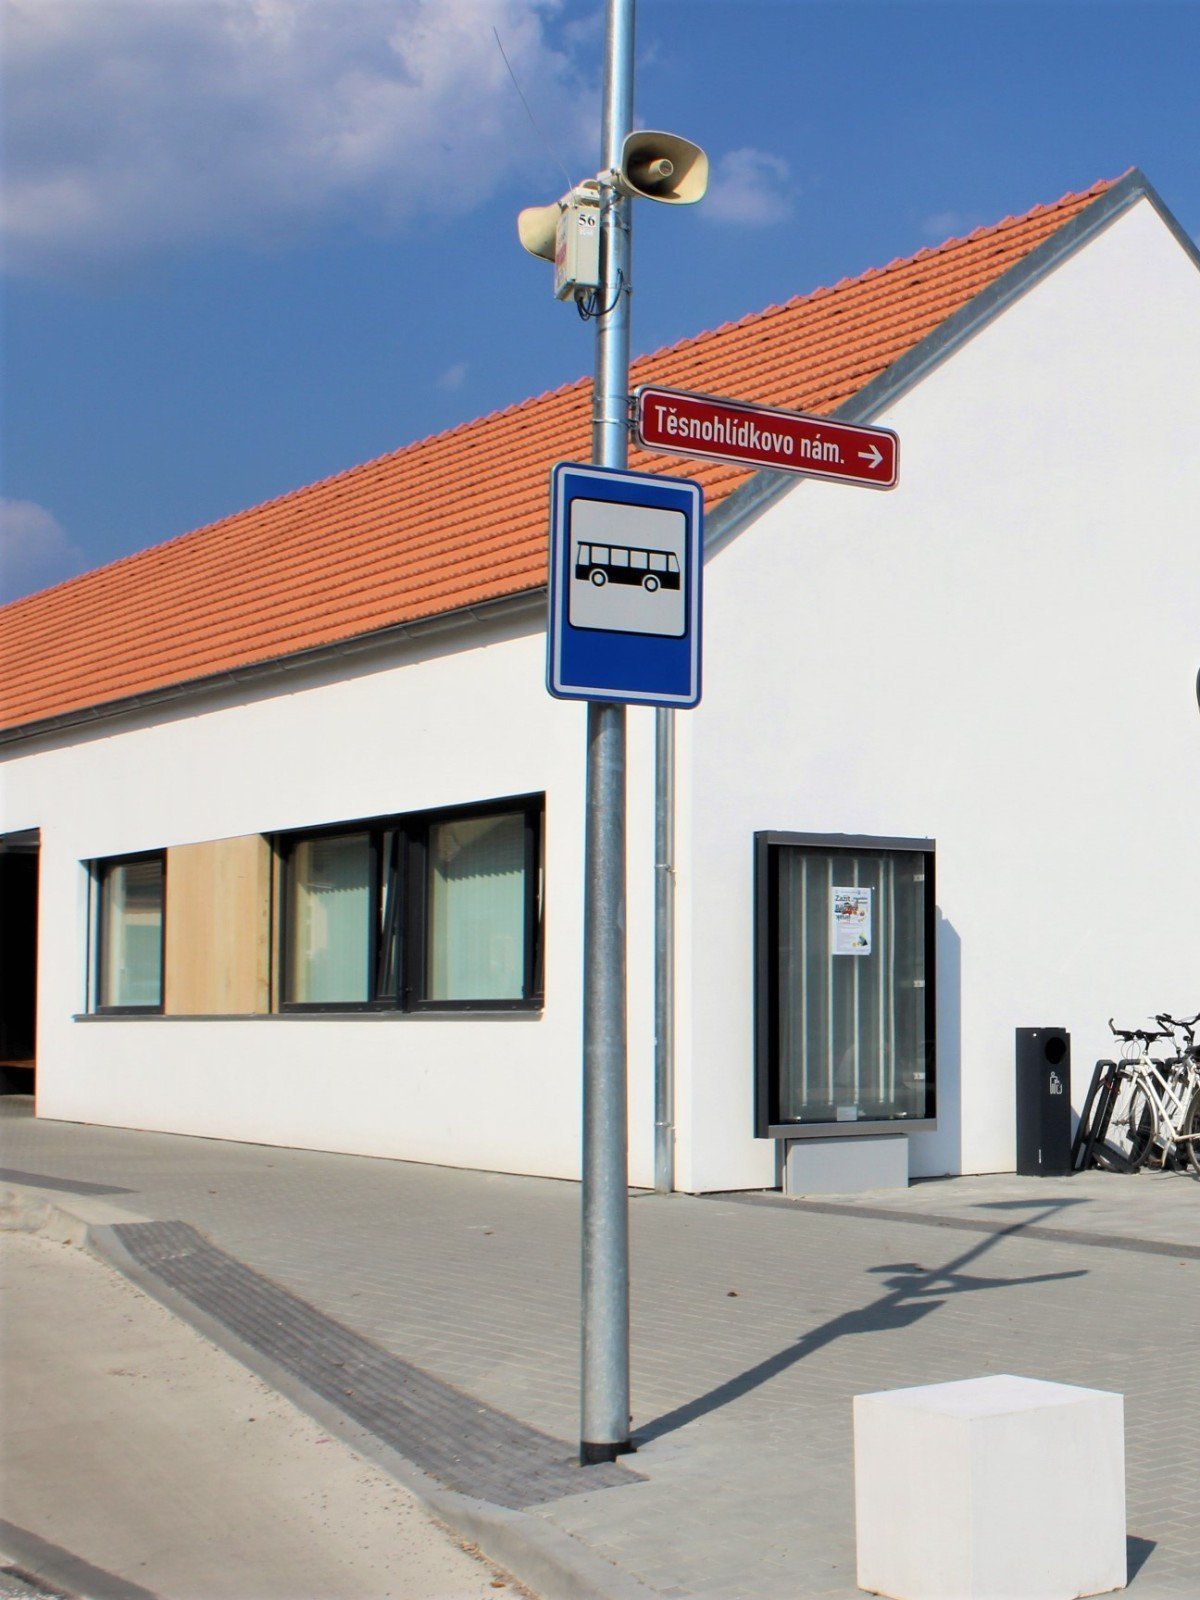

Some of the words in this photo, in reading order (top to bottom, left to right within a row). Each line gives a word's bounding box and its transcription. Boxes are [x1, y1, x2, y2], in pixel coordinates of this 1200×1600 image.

[578, 214, 596, 226] 56
[655, 405, 794, 455] Těsnohlídkovo
[800, 433, 845, 463] nám.
